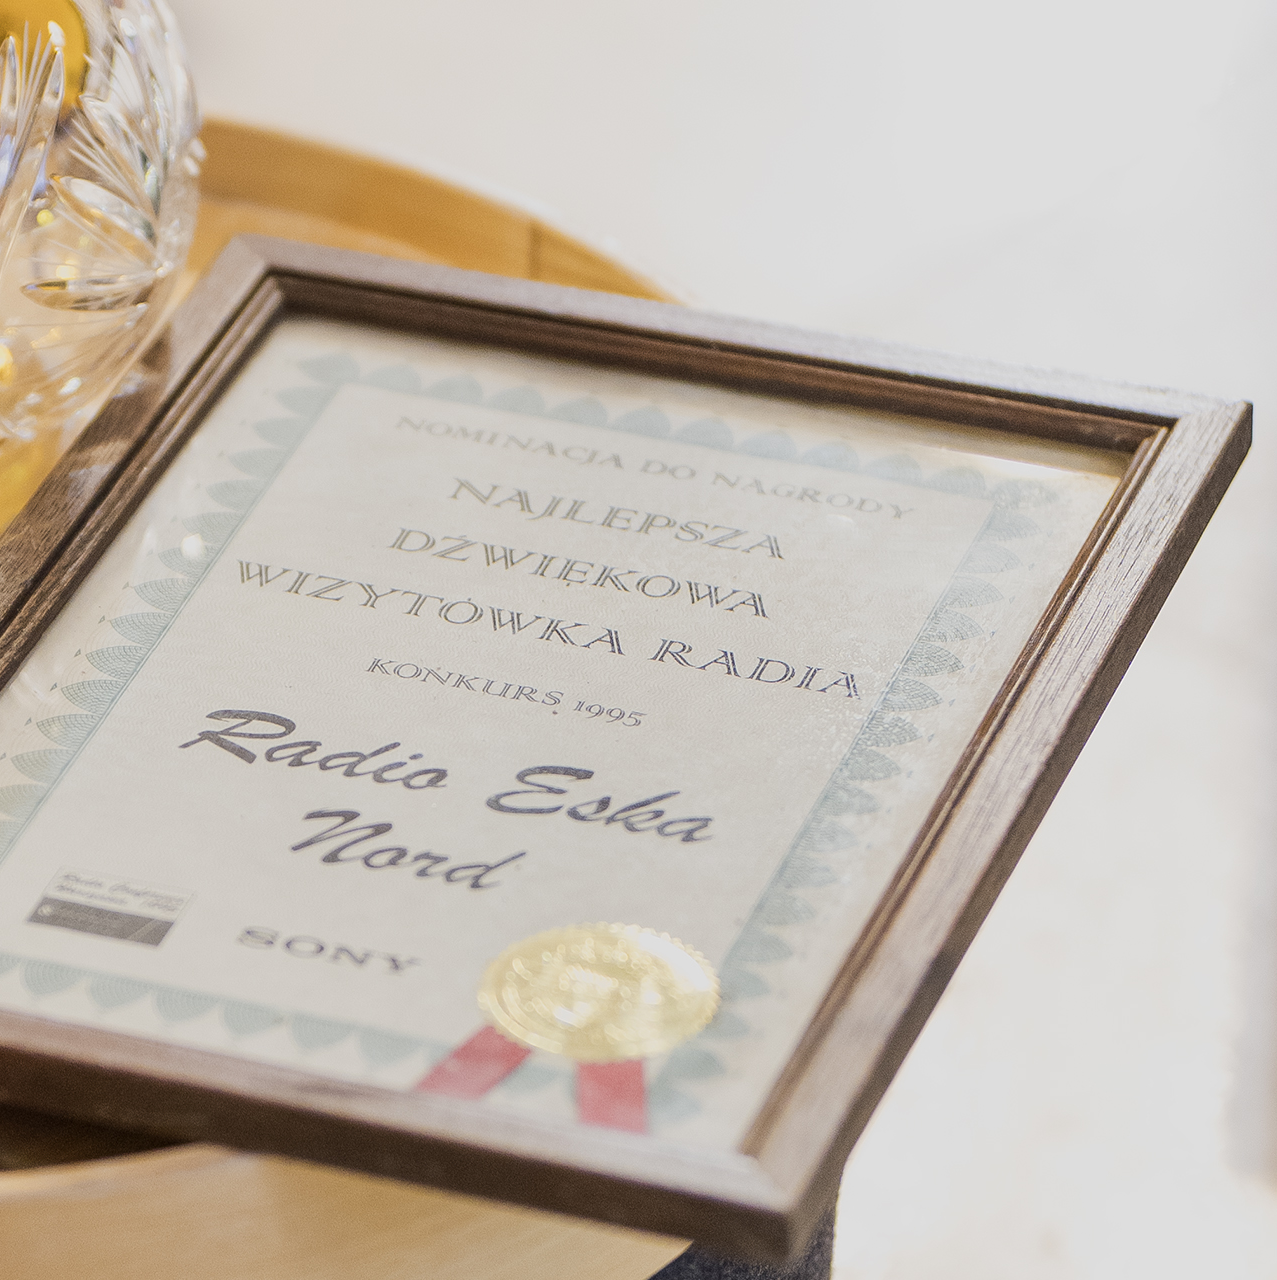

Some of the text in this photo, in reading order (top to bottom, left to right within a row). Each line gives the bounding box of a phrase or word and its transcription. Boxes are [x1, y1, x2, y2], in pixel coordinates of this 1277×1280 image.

[395, 414, 917, 520] NOMINACJA DO NAGRODY
[447, 477, 785, 560] NAJLEPSZA
[387, 526, 770, 619] DŹWIĘKOWA
[235, 558, 862, 700] WIZYTÓWKA RADIA
[365, 657, 648, 728] KONKURS 1995
[178, 709, 718, 844] Radio Eska
[290, 807, 528, 892] Nord
[233, 923, 422, 975] SONY
